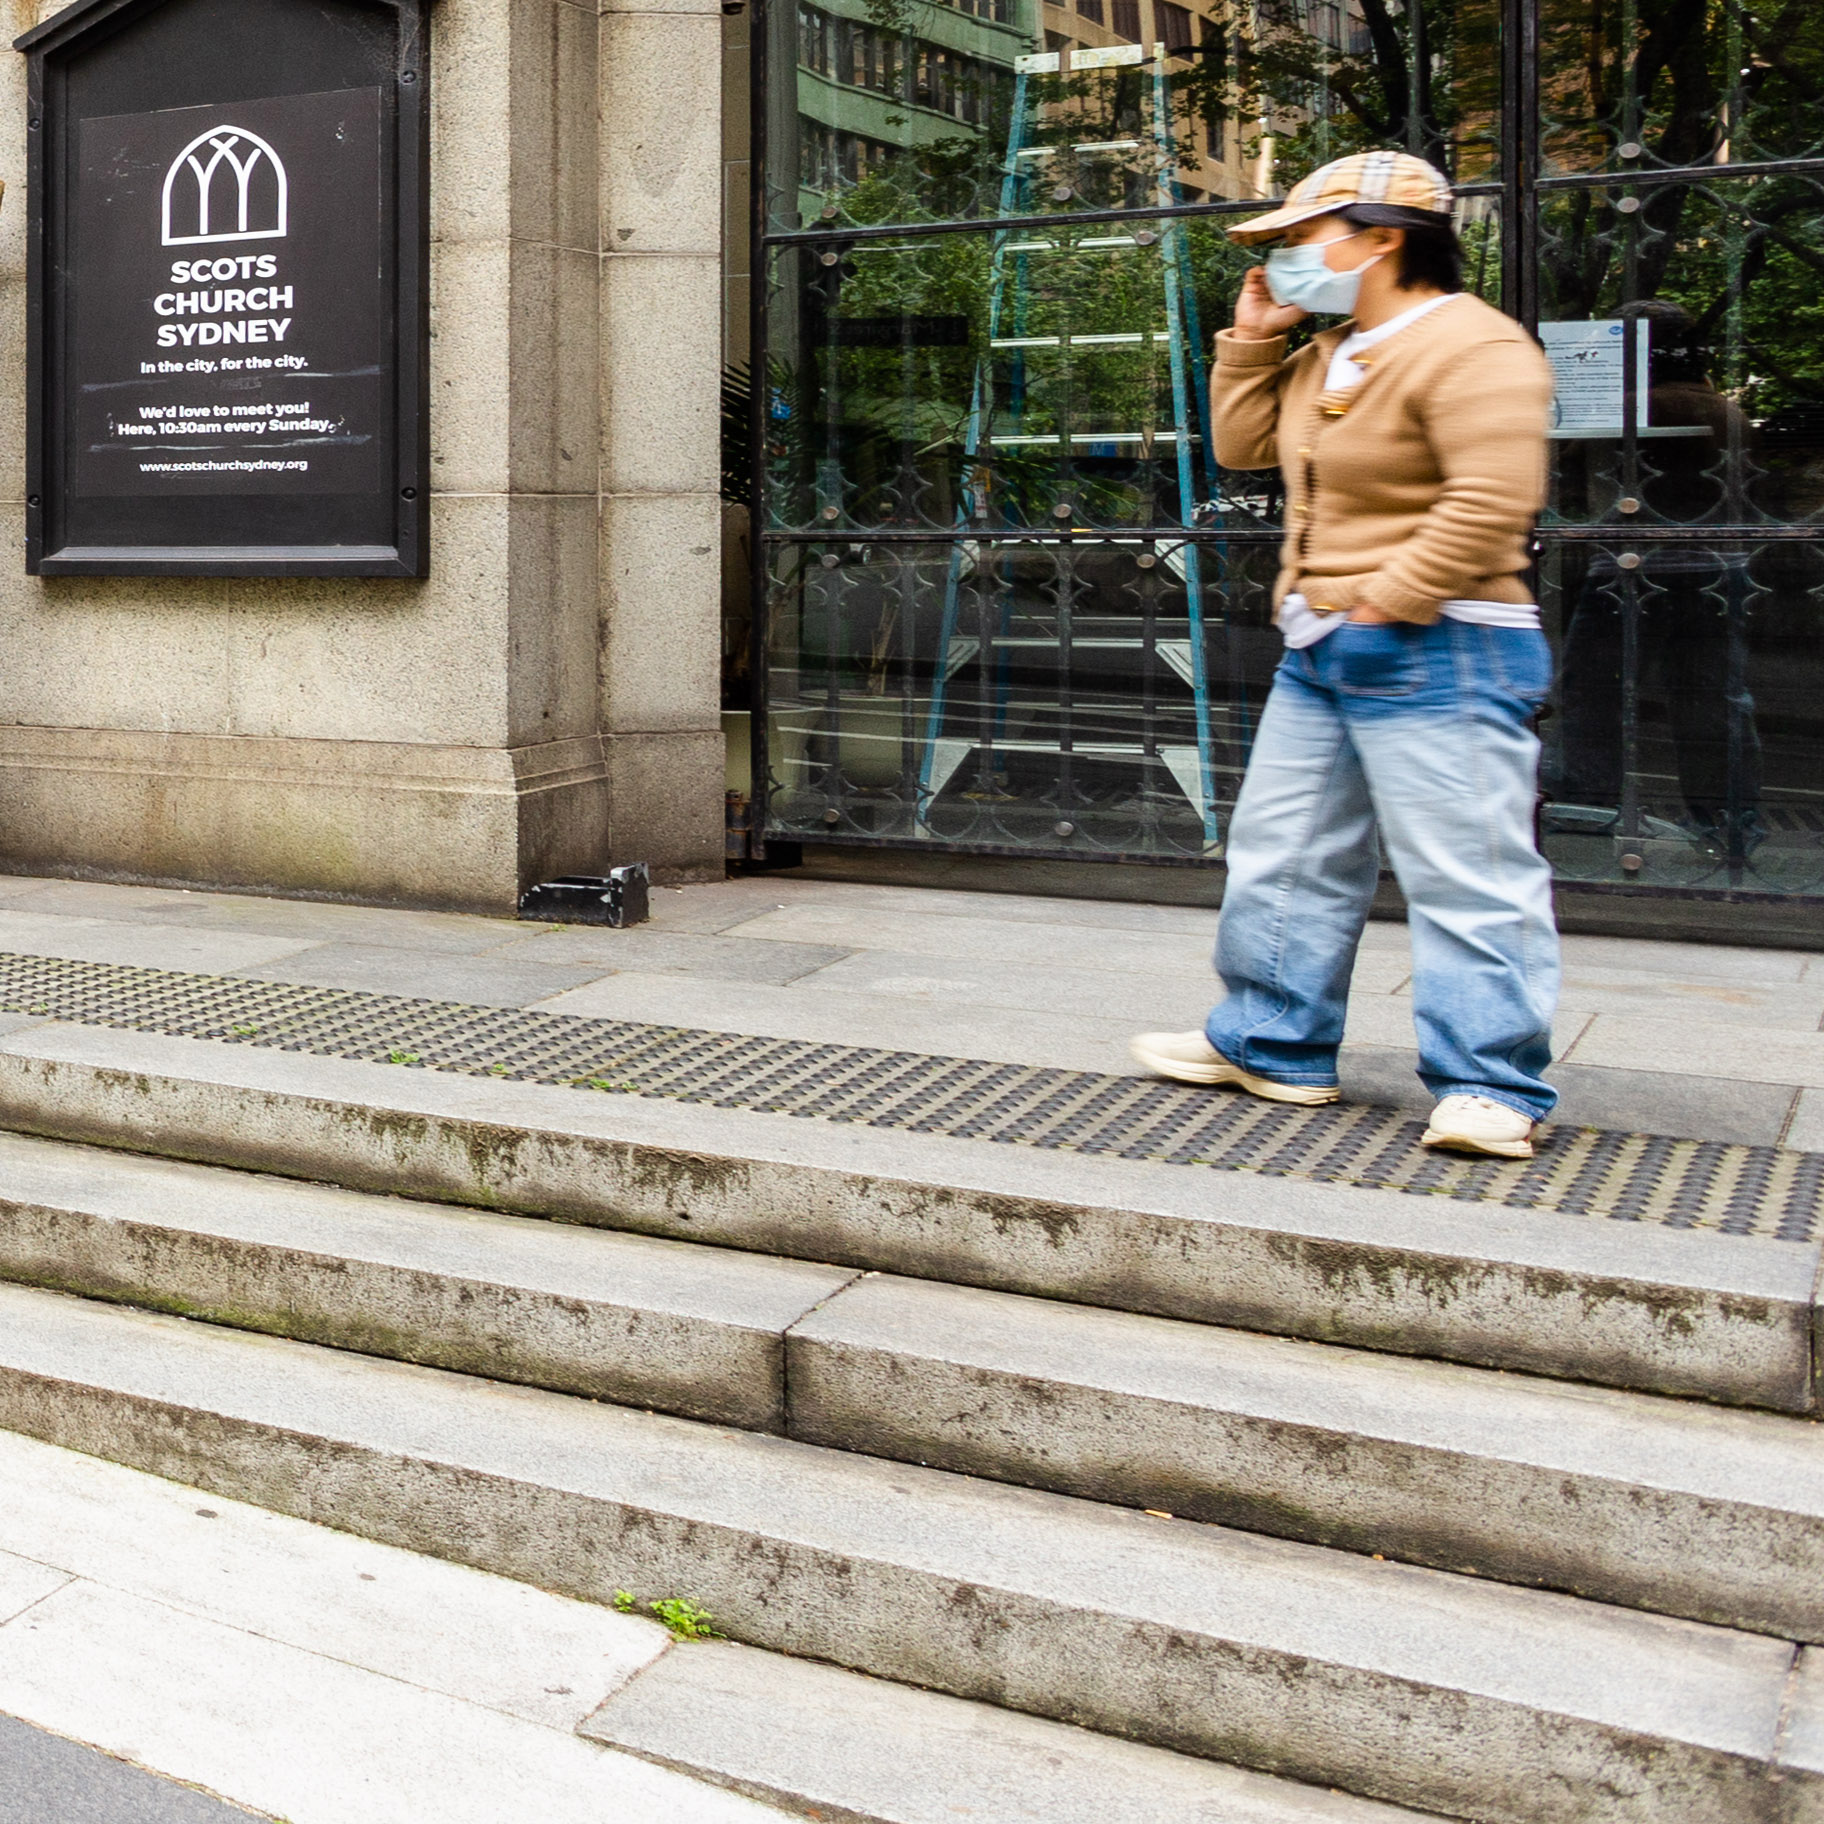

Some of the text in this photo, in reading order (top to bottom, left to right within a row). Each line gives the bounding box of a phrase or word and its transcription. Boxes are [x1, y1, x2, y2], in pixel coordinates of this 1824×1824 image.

[170, 254, 278, 284] SCOTS
[153, 285, 294, 316] CHURCH
[156, 317, 292, 347] SYDNEY
[140, 354, 309, 374] In the city, for the city.
[139, 402, 310, 419] We'd love to meet you!
[118, 423, 157, 436] Here,
[158, 421, 221, 435] 10:30am
[224, 421, 267, 434] every
[139, 459, 308, 473] www.scotschurchsydney.org
